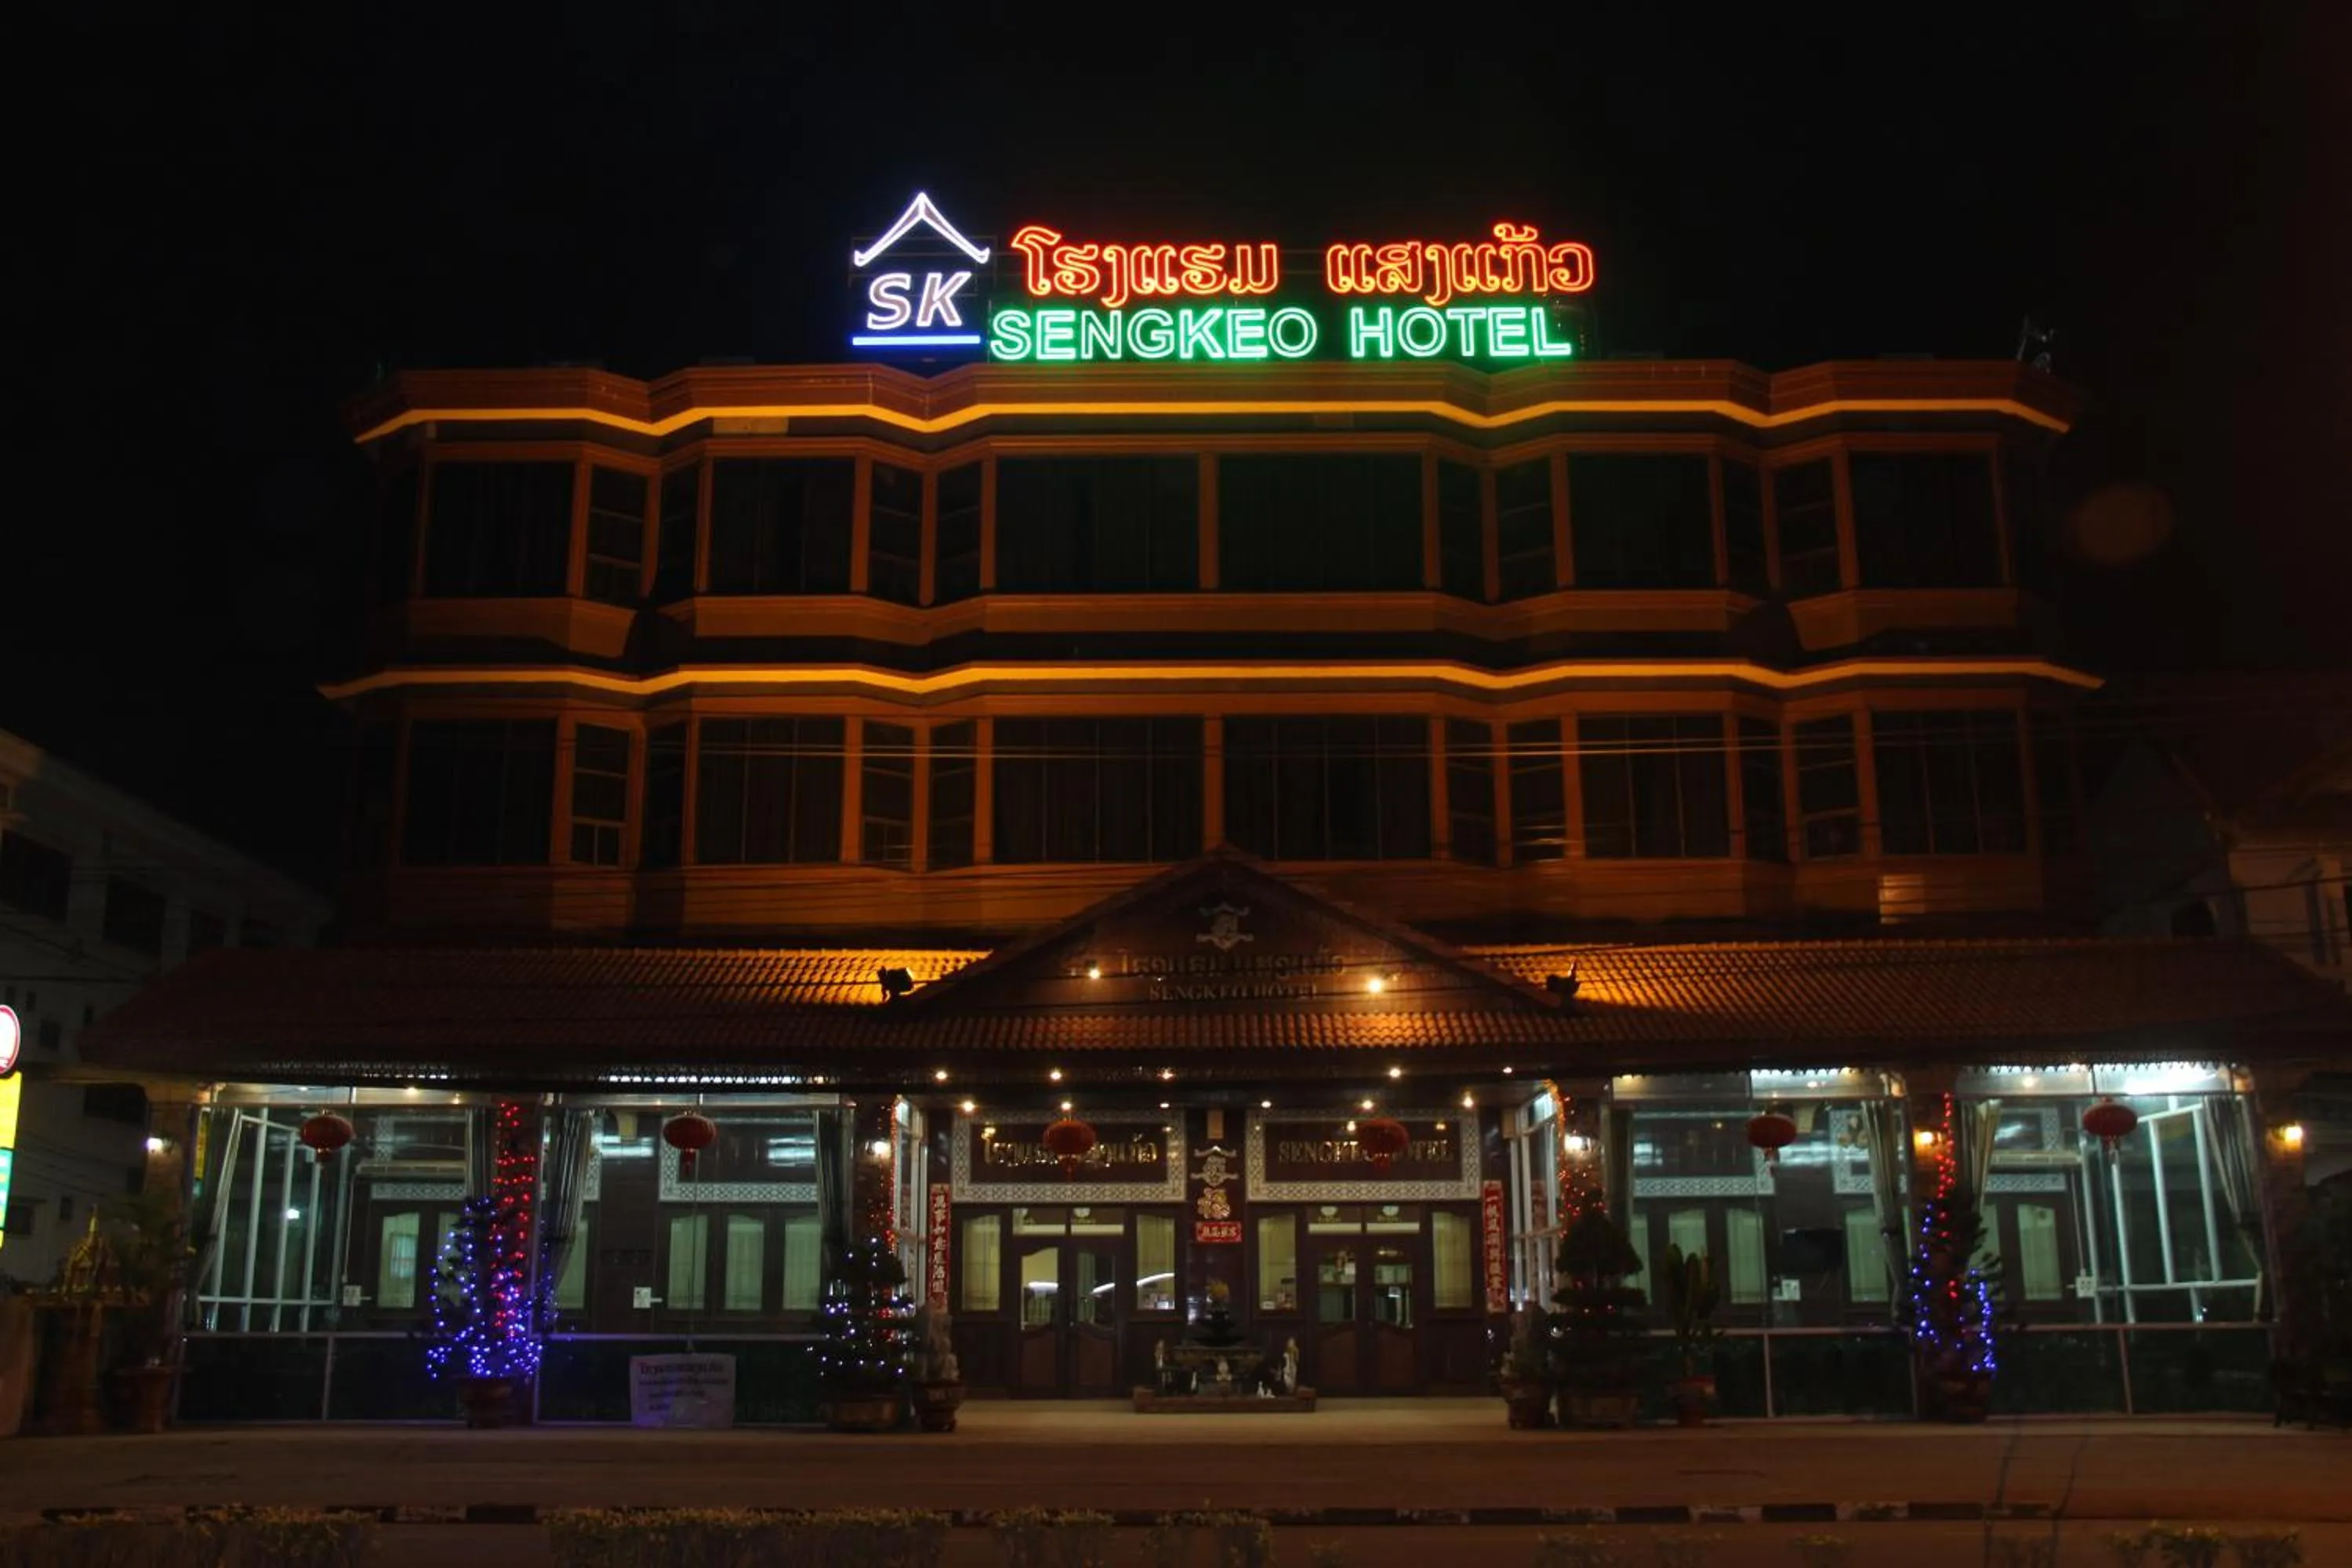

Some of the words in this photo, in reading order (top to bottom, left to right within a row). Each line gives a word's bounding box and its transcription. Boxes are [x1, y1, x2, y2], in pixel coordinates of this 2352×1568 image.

[1011, 225, 1279, 307] ໂຮງແຮມ
[1326, 222, 1594, 307] ແສງແກ້ວ
[866, 271, 972, 330] SK
[989, 307, 1318, 361] SENGKEO
[1349, 306, 1572, 358] HOTEL
